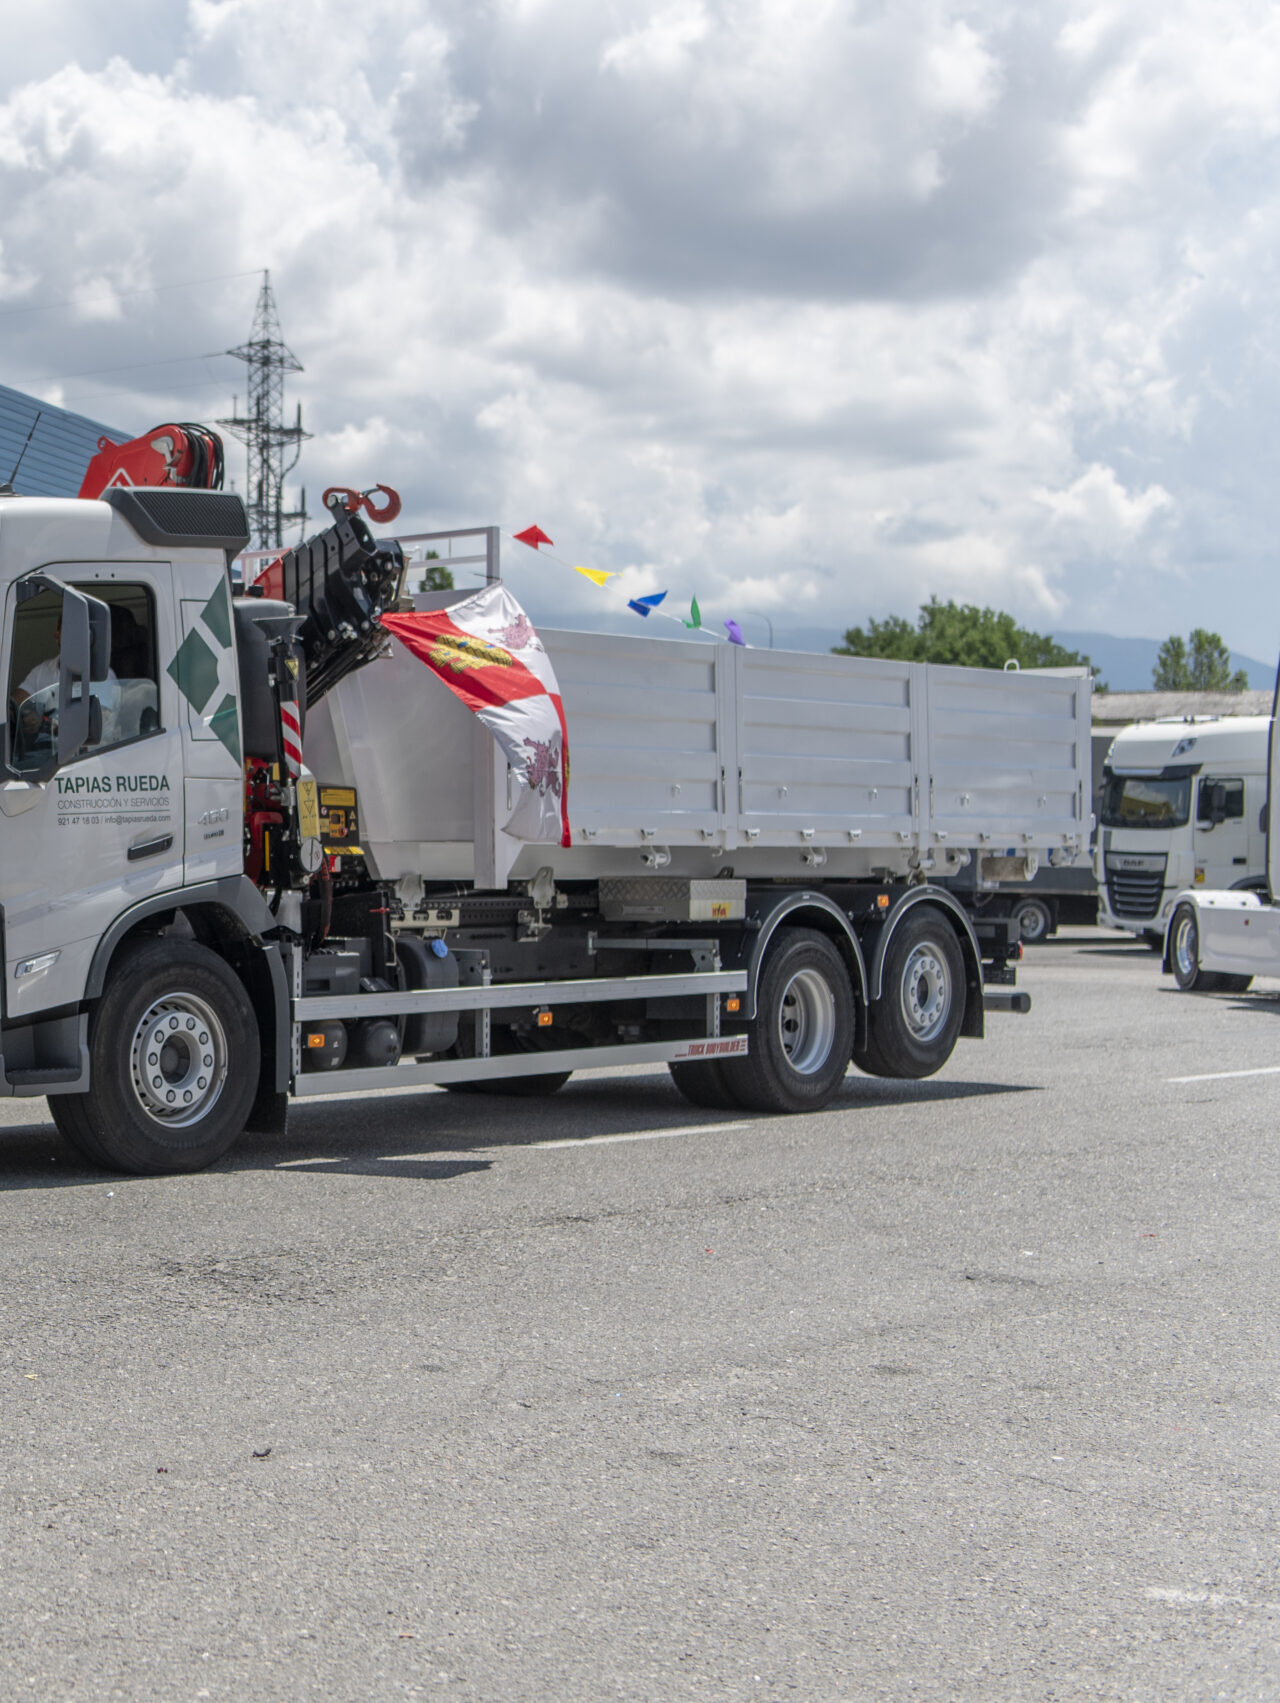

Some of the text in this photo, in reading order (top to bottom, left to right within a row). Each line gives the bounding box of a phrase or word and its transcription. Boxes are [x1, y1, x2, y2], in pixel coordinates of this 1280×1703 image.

[55, 775, 170, 793] TAPIAS RUEDA
[57, 797, 170, 809] CONSTRUCCIÓN Y SERVICIOS
